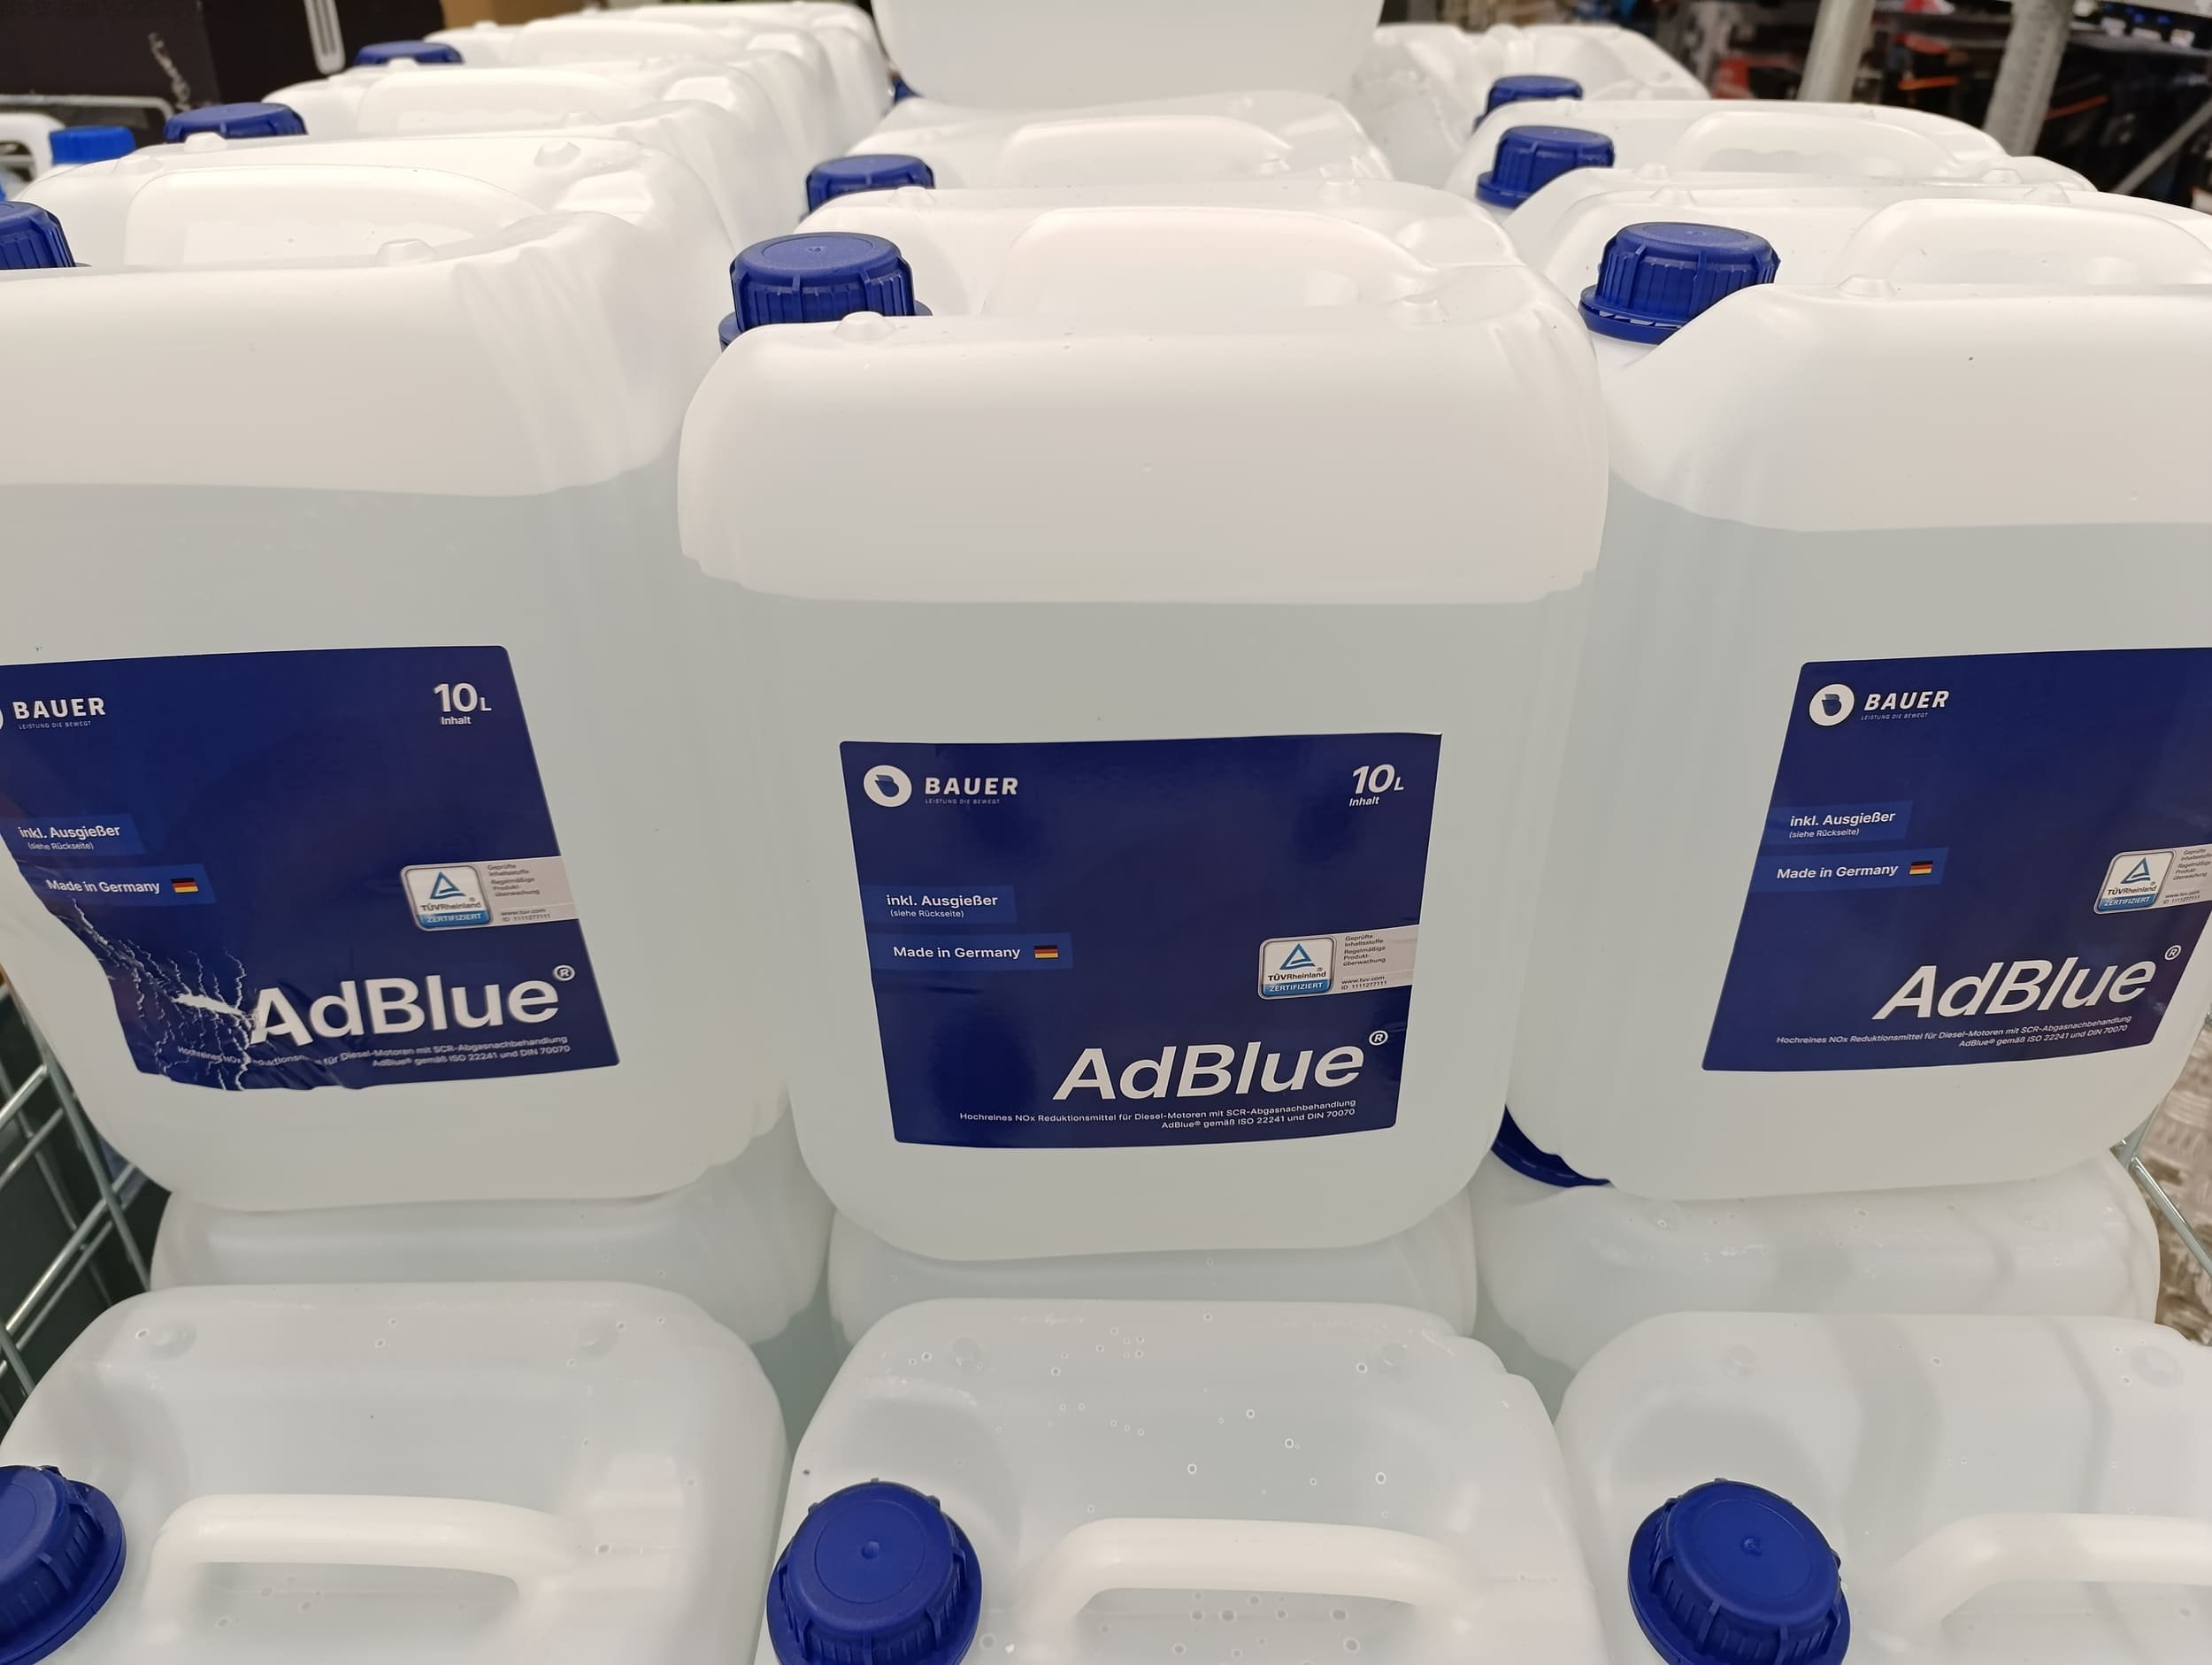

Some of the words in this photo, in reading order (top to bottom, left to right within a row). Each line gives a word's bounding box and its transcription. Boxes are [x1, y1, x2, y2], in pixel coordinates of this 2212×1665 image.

[1863, 690, 1950, 711] BAUER
[12, 697, 106, 719] BAUER
[441, 716, 472, 725] Inhalt
[925, 778, 1018, 795] BAUER
[1348, 796, 1380, 807] Inhalt
[1790, 816, 1819, 827] inkl.
[1823, 812, 1896, 827] Ausgießer
[18, 826, 47, 839] inkl.
[50, 825, 120, 840] Ausgießer
[1816, 828, 1860, 838] Rückseite)
[52, 841, 94, 850] Rückseite)
[1777, 868, 1816, 879] Made
[1819, 867, 1832, 878] in
[1836, 865, 1899, 877] Germany
[46, 879, 81, 892] Made
[85, 881, 96, 893] in
[99, 882, 159, 894] Germany
[887, 894, 918, 906] inkl.
[922, 895, 998, 909] Ausgießer
[2104, 896, 2150, 907] ZERTIFIZIERT
[427, 914, 482, 924] ZERTIFIZIERT
[918, 909, 964, 918] Rückseite)
[1344, 939, 1384, 948] Inhaltsstoffe
[893, 947, 934, 957] Made
[938, 948, 950, 957] in
[955, 948, 1020, 960] Germany
[1343, 957, 1386, 966] überwachung
[1269, 982, 1324, 992] ZERTIFIZIERT
[1341, 976, 1386, 985] www.tuv.com
[1850, 1033, 1924, 1043] Reduktionsmittel
[1939, 1029, 2004, 1039] Diesel-Motoren
[2020, 1016, 2132, 1034] SCR-Abgasnachbehandlung
[2103, 1024, 2128, 1034] 70070
[416, 1046, 432, 1055] mit
[434, 1035, 568, 1053] SCR-Abgasnachbehandlung
[449, 1054, 466, 1063] ISO
[500, 1050, 518, 1059] und
[521, 1047, 538, 1057] DIN
[541, 1045, 571, 1055] 70070
[960, 1112, 1013, 1122] Hochreines
[1038, 1114, 1117, 1123] Reduktionsmittel
[1134, 1110, 1206, 1121] Diesel-Motoren
[1226, 1099, 1356, 1117] SCR-Abgasnachbehandlung
[1203, 1118, 1235, 1129] gemäß
[1256, 1116, 1286, 1124] 22241
[1287, 1114, 1305, 1123] und
[1308, 1111, 1325, 1121] DIN
[1326, 1109, 1356, 1118] 70070
